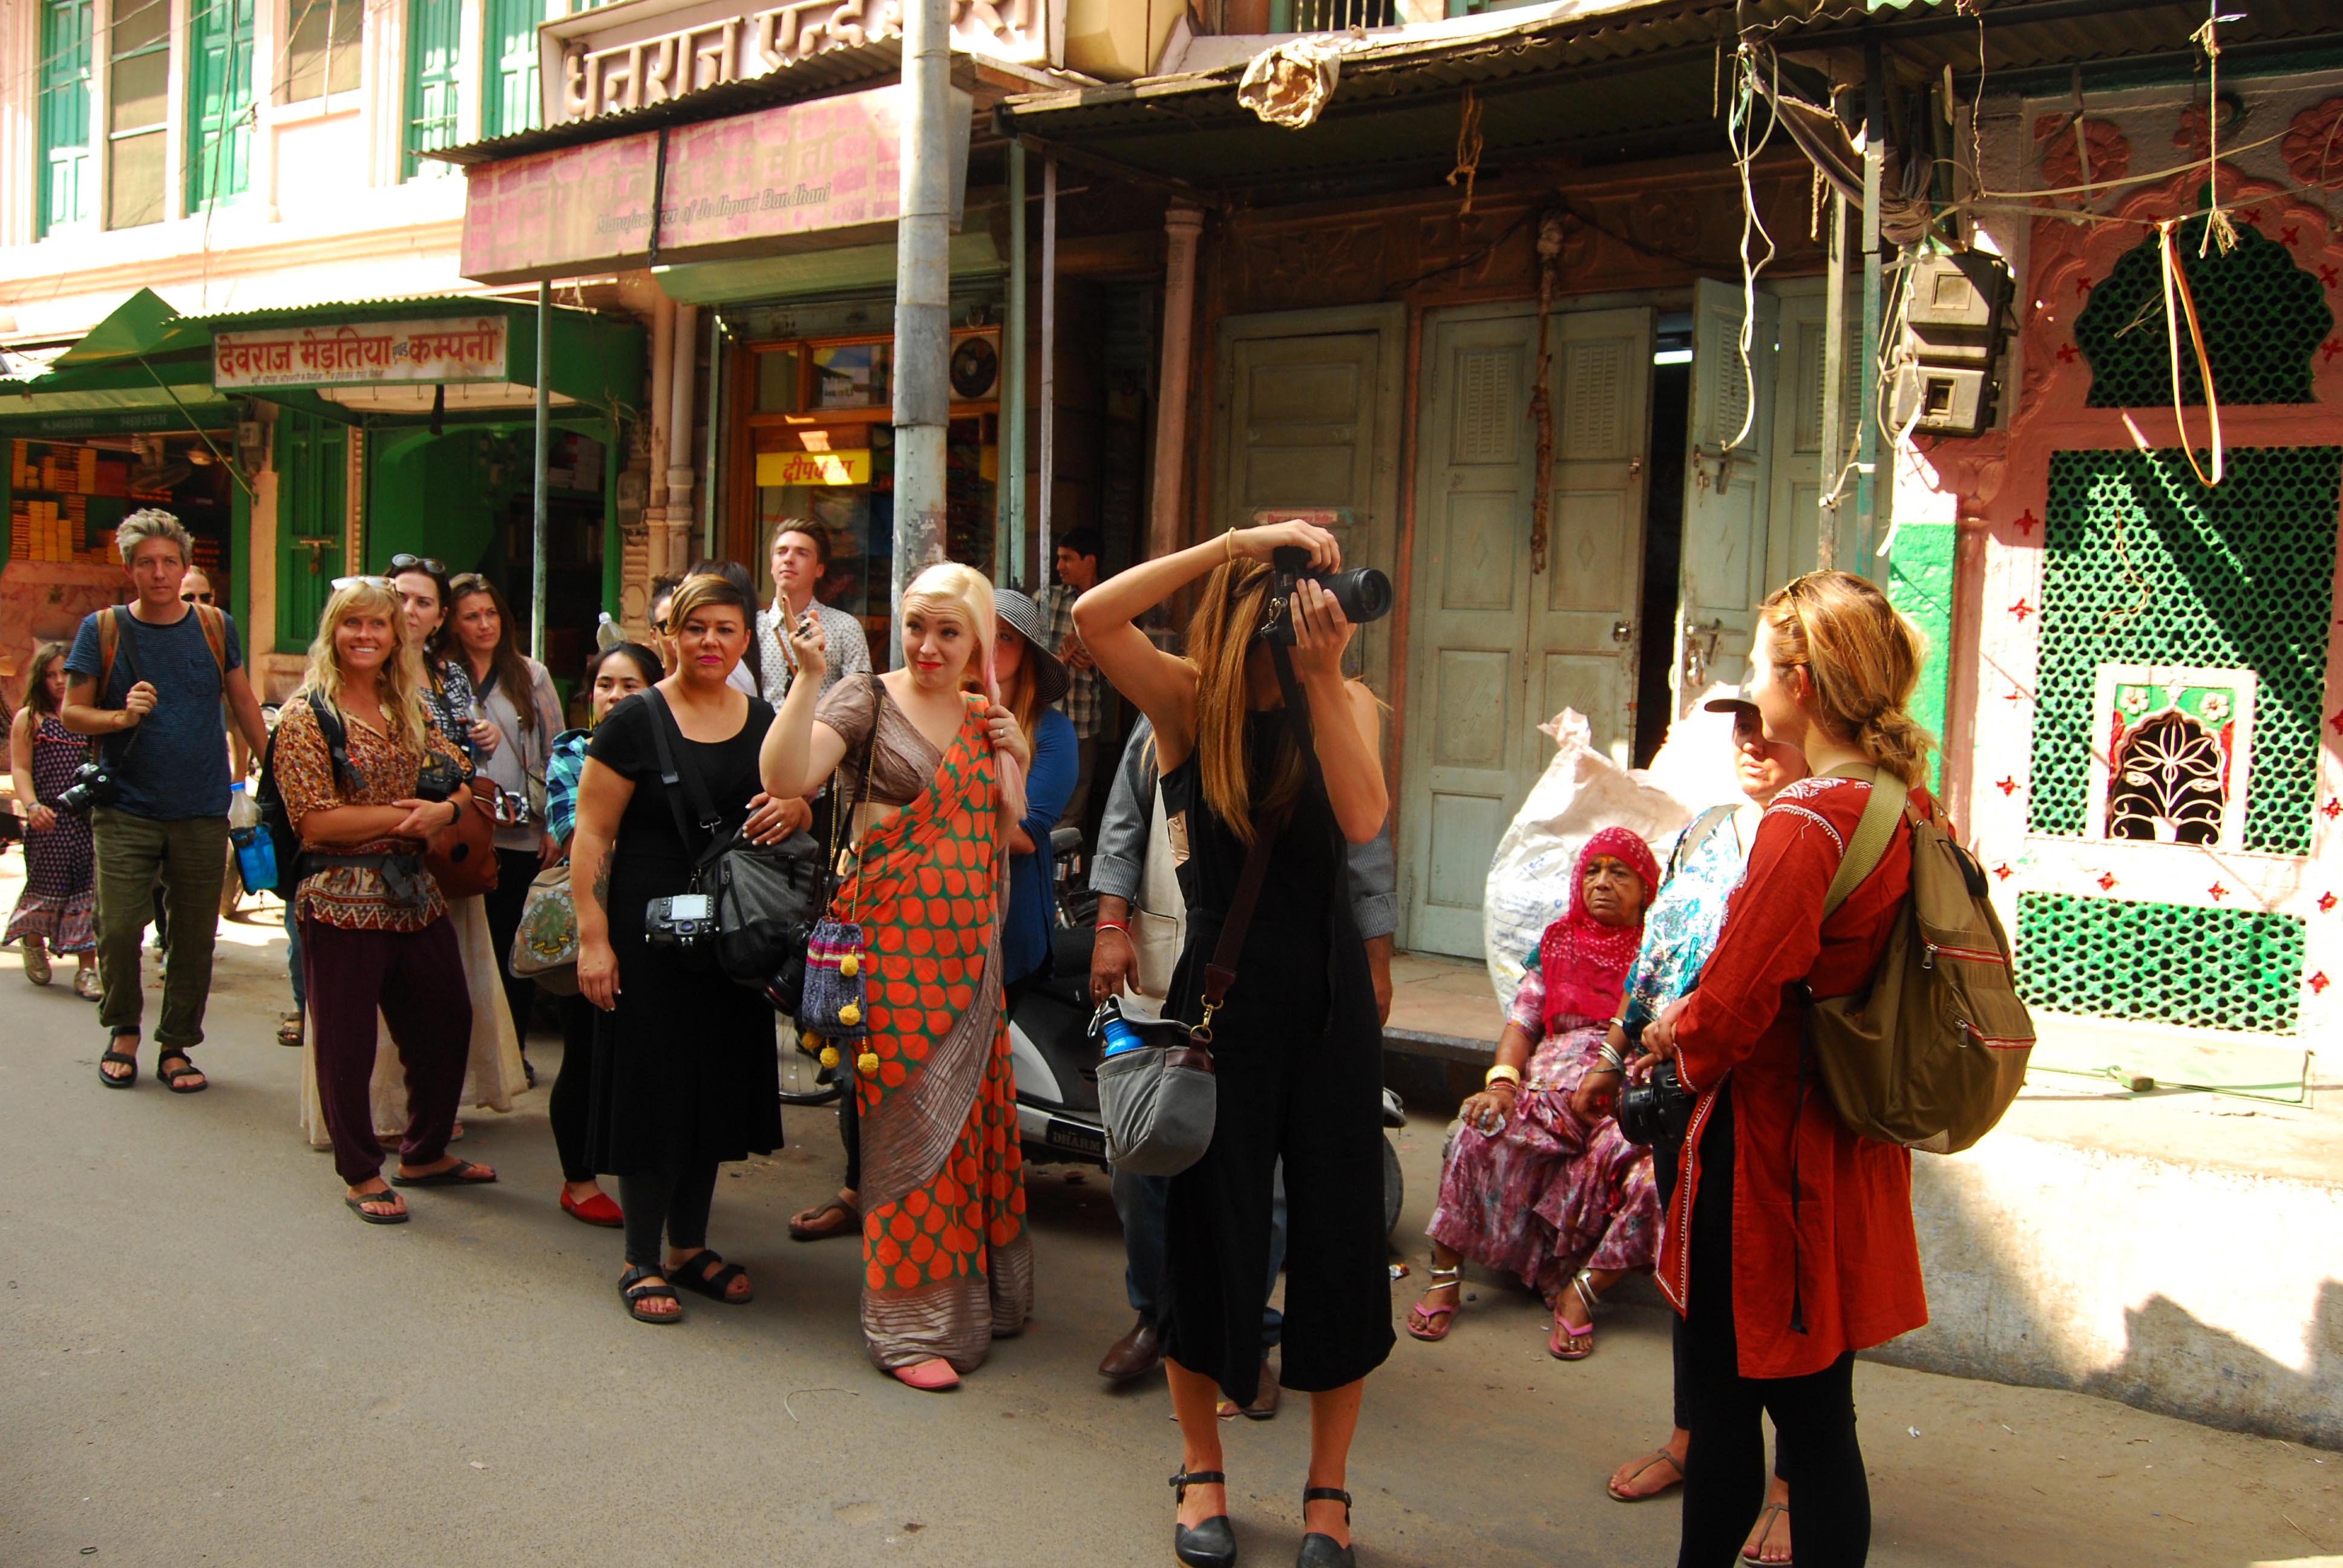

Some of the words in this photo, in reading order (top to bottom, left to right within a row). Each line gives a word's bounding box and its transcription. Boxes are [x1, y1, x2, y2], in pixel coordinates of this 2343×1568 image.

[595, 208, 679, 234] Manufactrer
[681, 199, 697, 226] of
[697, 192, 759, 220] Jodhpuri
[761, 182, 831, 211] Bandhani
[218, 335, 294, 378] देवराज
[408, 319, 498, 364] कम्पनी
